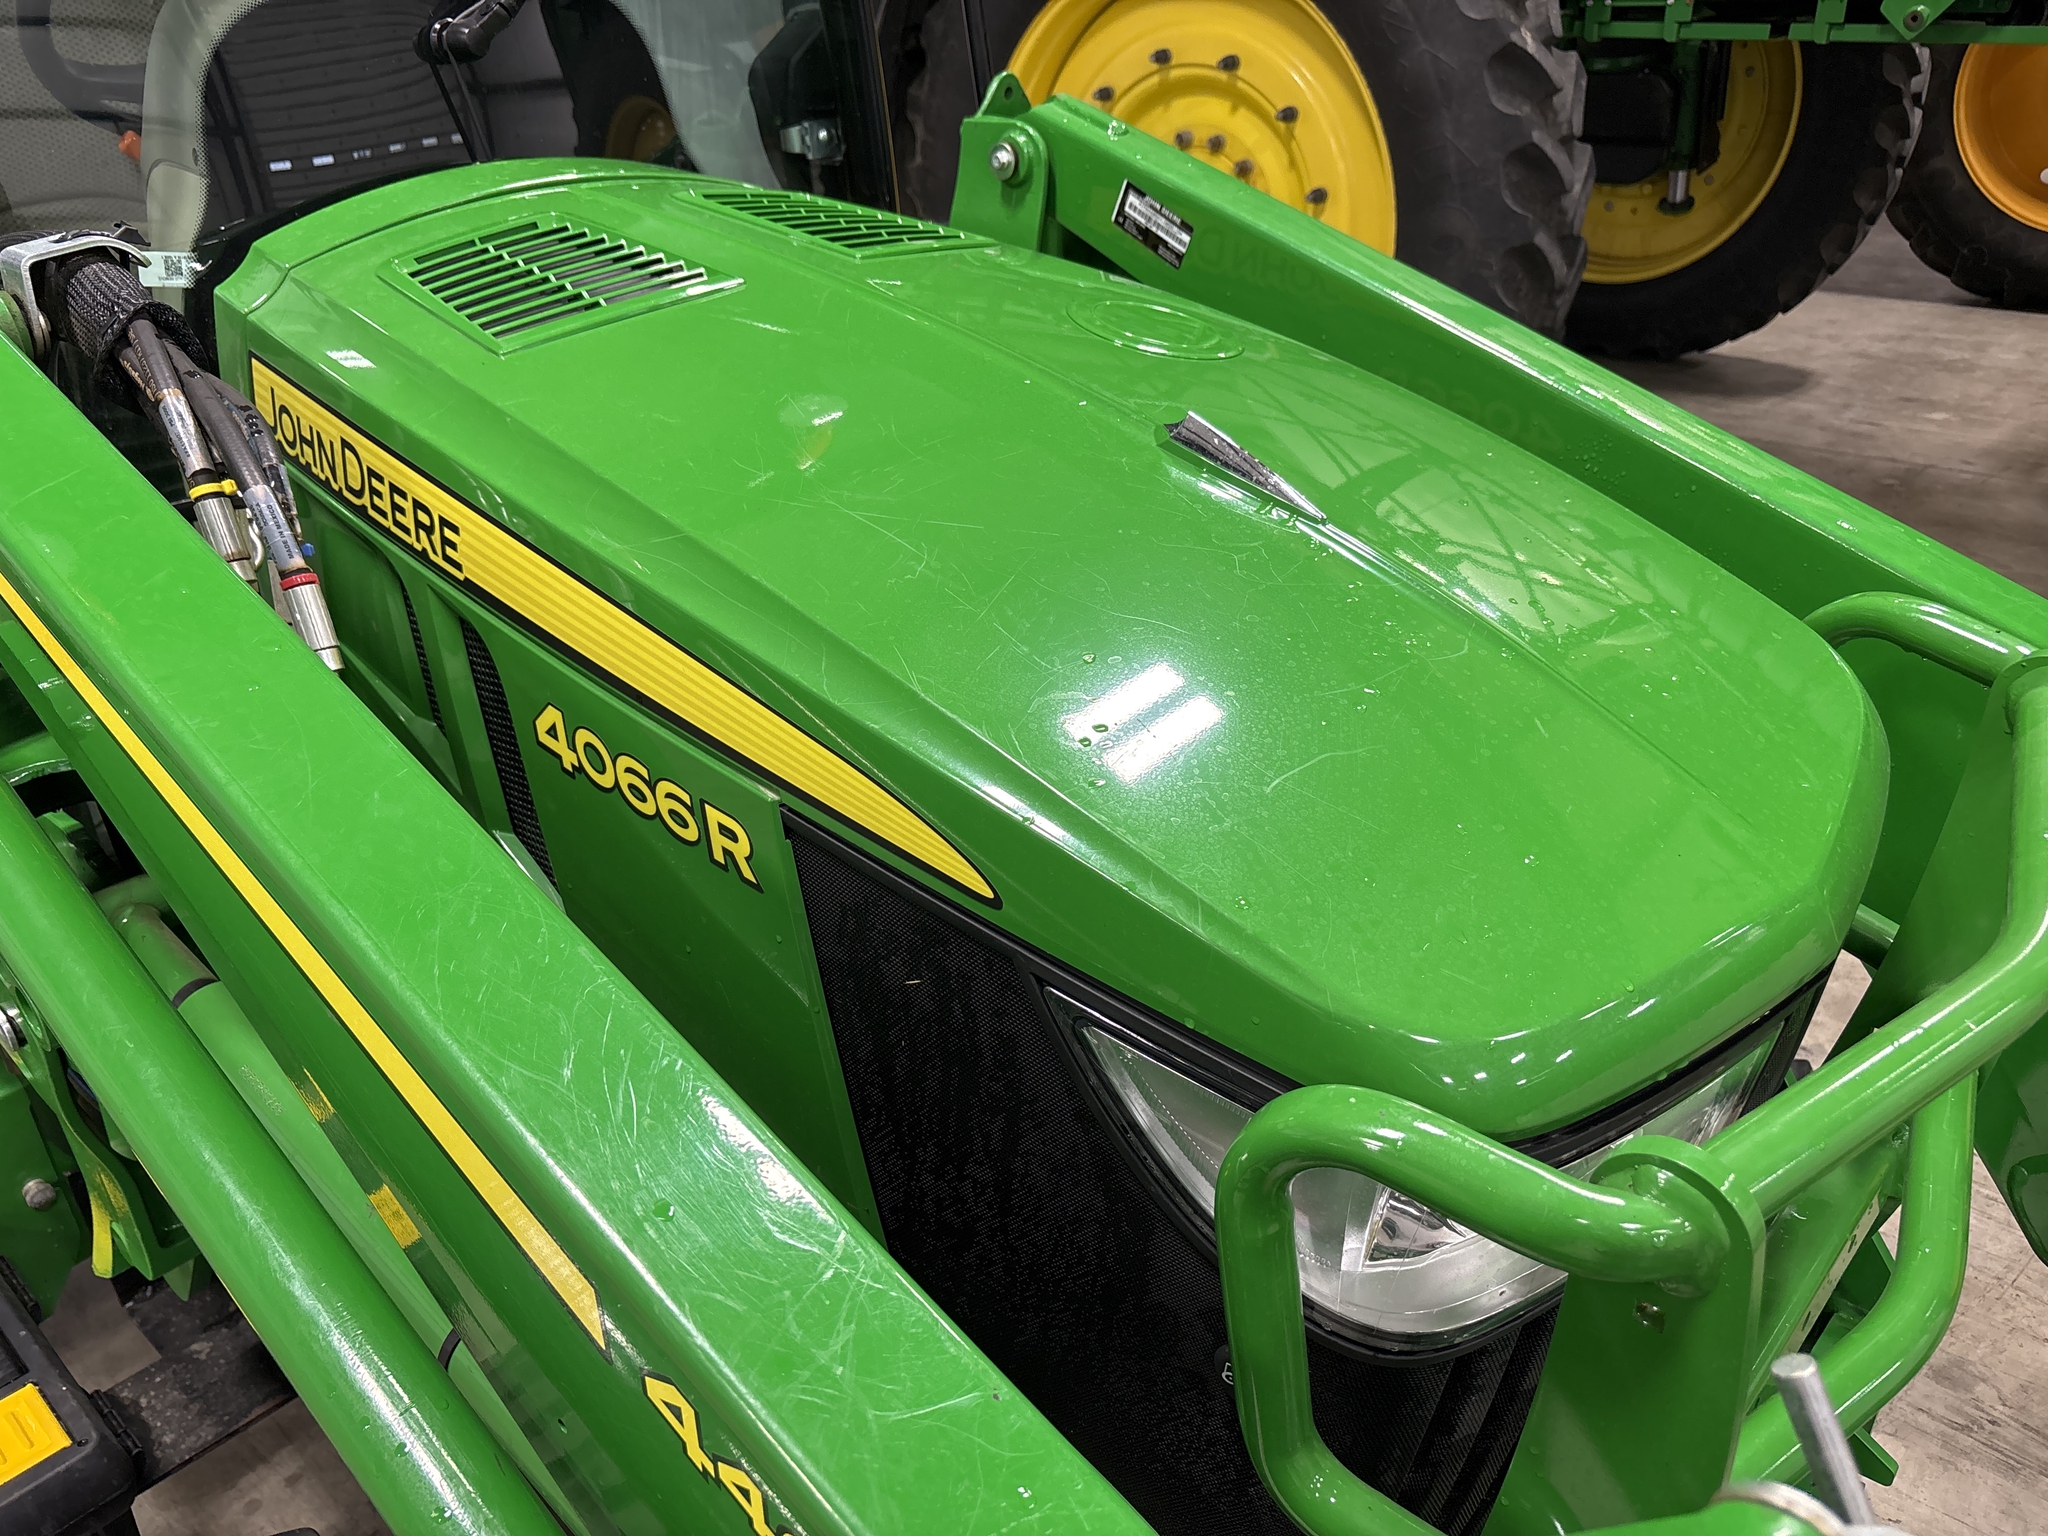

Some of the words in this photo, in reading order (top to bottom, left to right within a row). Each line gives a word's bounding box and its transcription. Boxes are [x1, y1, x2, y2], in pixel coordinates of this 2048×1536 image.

[267, 384, 337, 489] JOHN
[340, 435, 465, 577] DEERE
[267, 504, 282, 530] MEXICO
[278, 531, 286, 539] IN
[282, 540, 294, 559] MADE
